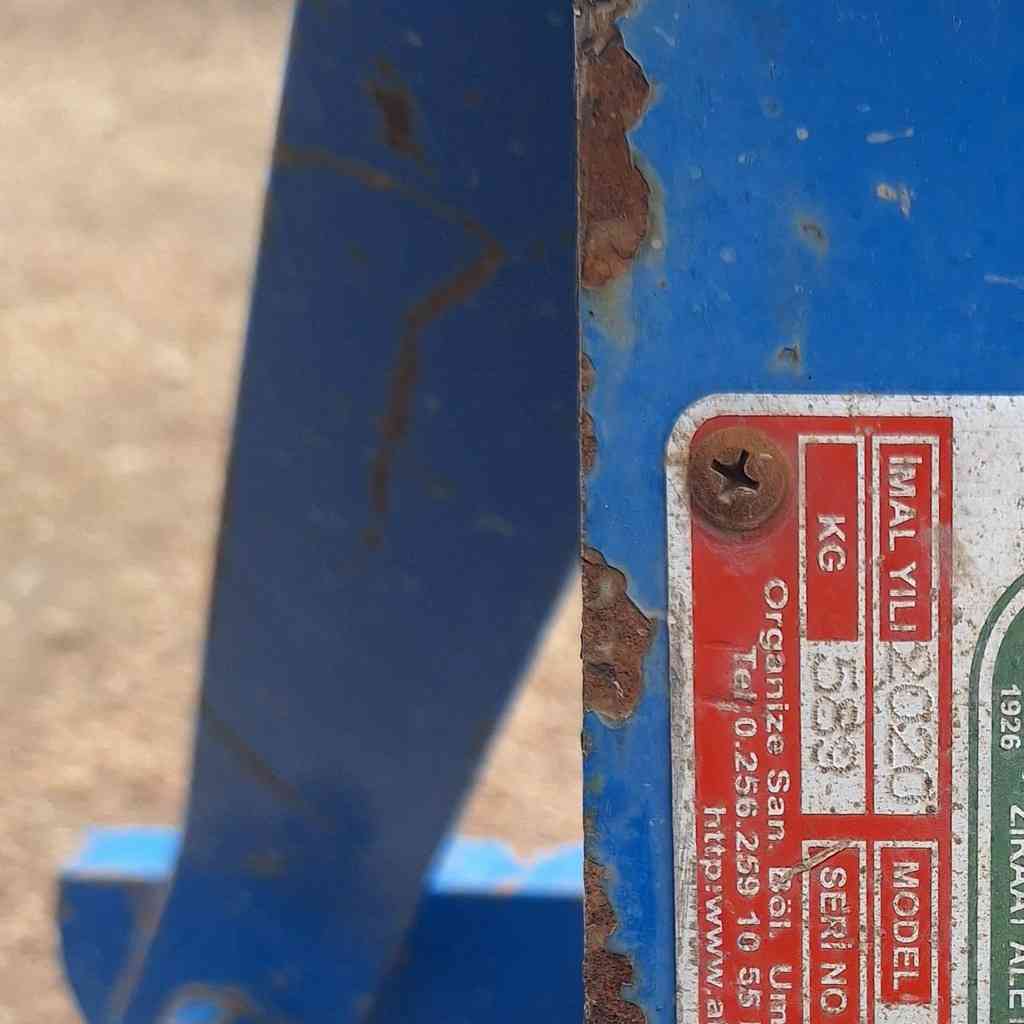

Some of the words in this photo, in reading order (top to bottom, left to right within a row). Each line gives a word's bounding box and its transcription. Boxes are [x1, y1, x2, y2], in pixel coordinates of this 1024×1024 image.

[817, 514, 847, 573] KG
[888, 455, 923, 551] İMAL
[888, 560, 918, 631] YILI
[759, 577, 790, 756] Organize
[811, 653, 860, 776] 589
[887, 643, 934, 806] 2020
[999, 685, 1020, 751] 1926
[766, 768, 790, 849] San.
[736, 911, 760, 952] 10
[821, 866, 853, 950] SERİ
[892, 860, 919, 990] MODEL
[737, 967, 760, 1008] 55
[820, 962, 847, 1015] NO
